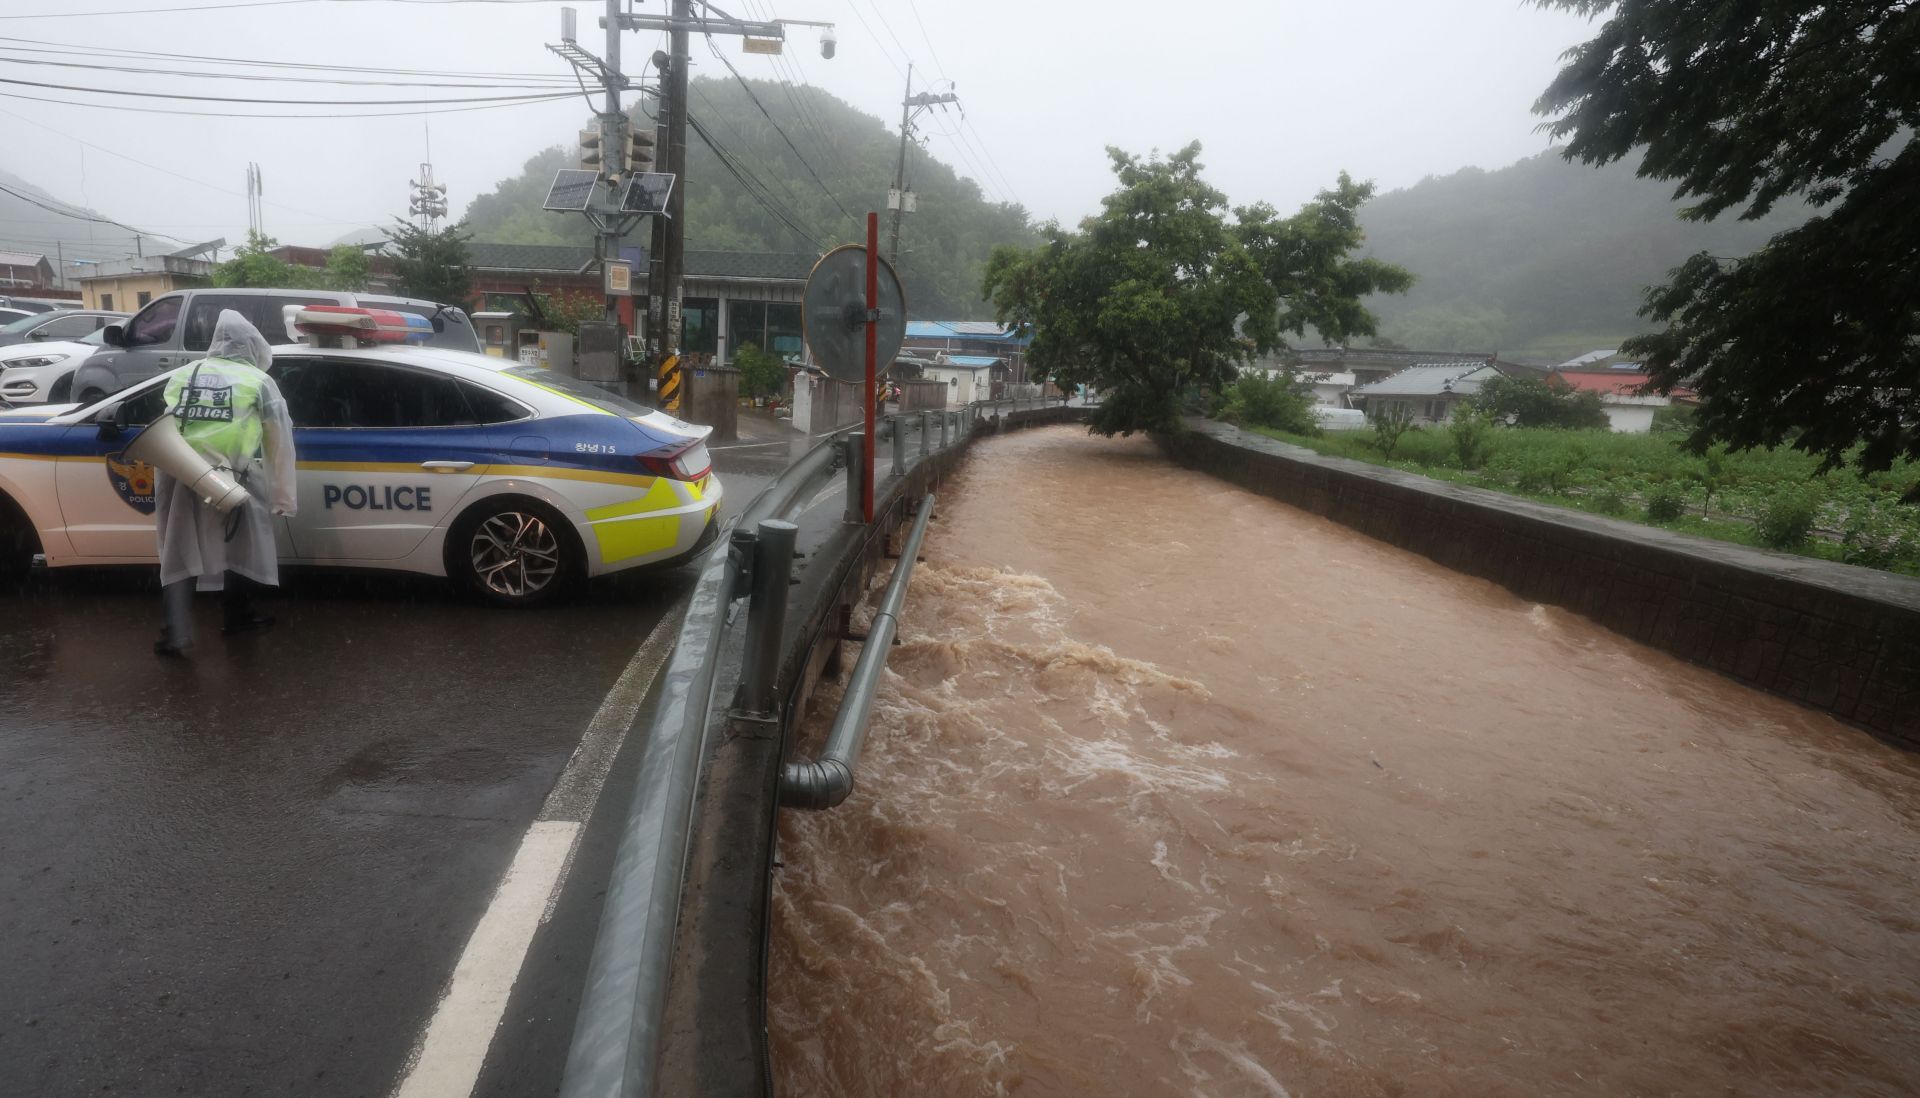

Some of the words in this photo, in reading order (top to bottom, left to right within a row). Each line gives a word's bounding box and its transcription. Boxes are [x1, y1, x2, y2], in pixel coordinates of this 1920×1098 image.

[176, 407, 230, 419] POLICE
[575, 442, 599, 453] 창녕
[602, 445, 616, 454] 15
[323, 484, 432, 511] POLICE
